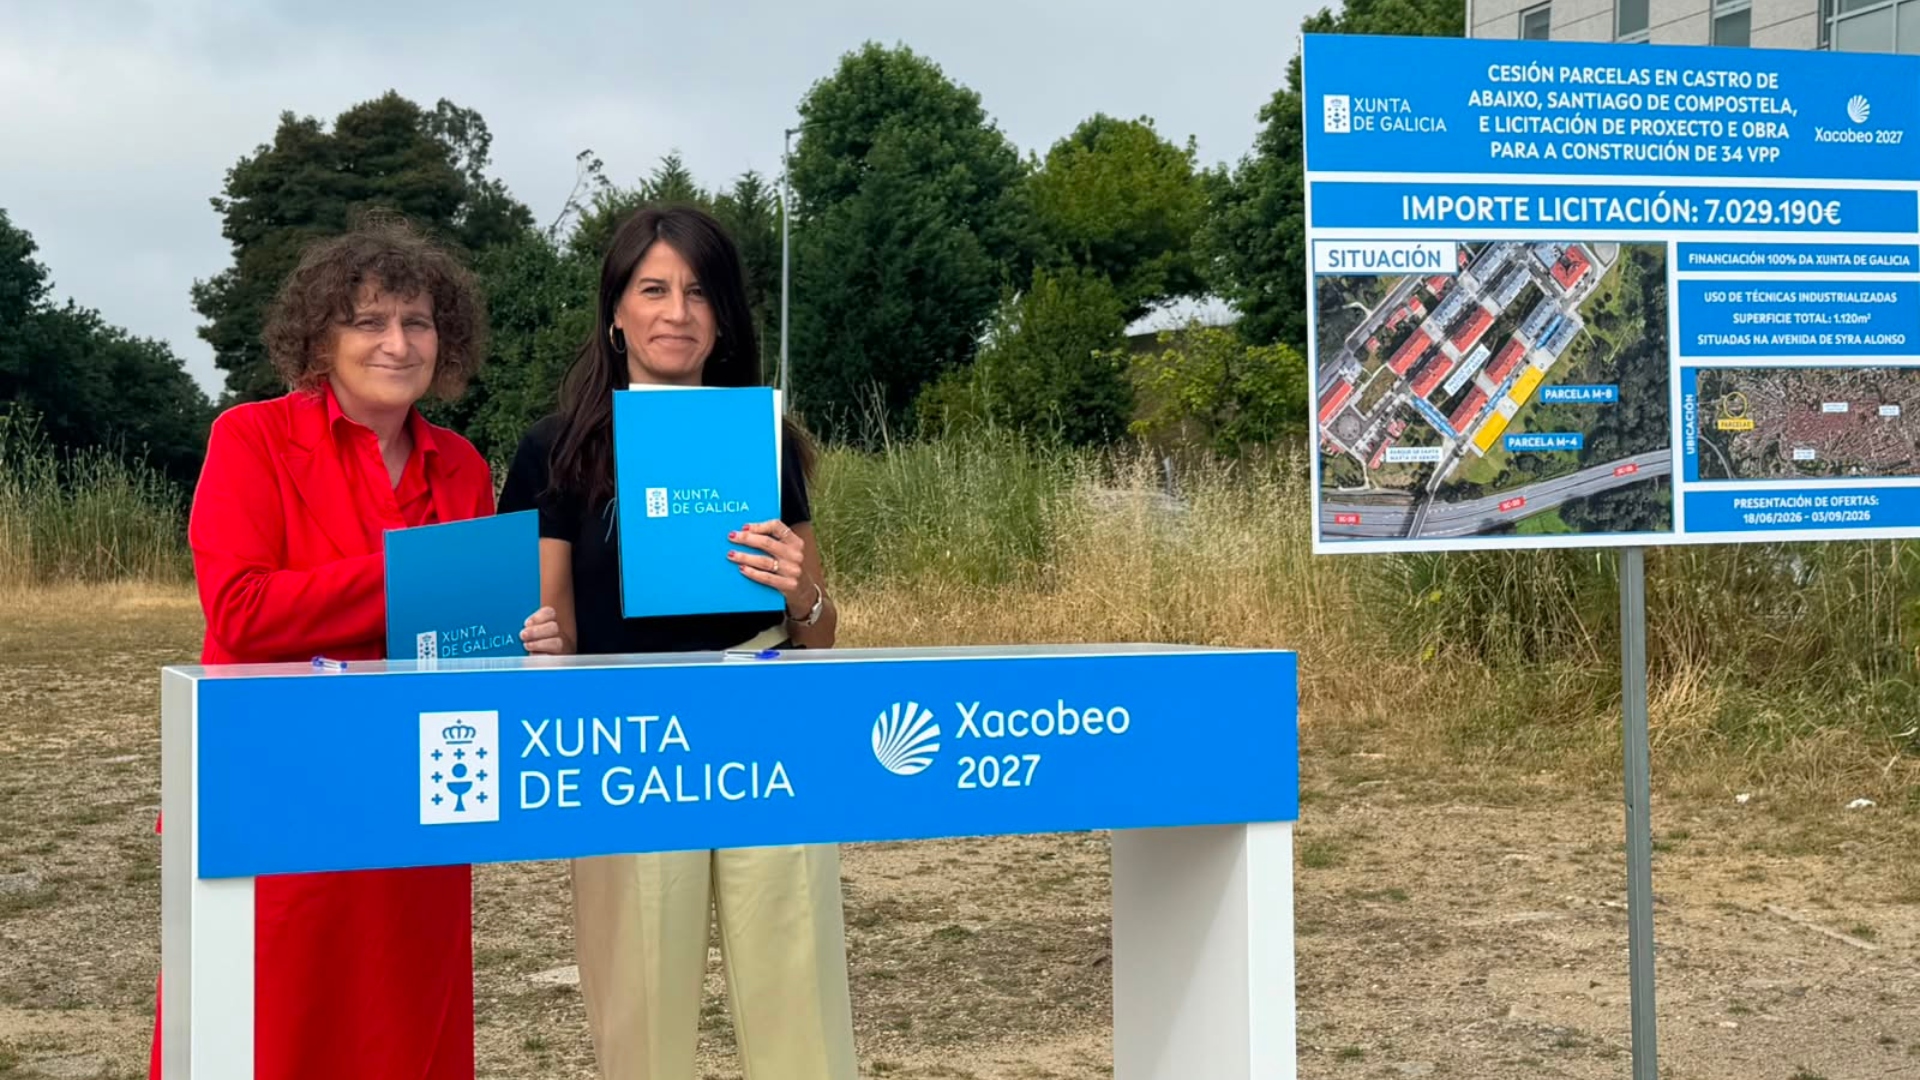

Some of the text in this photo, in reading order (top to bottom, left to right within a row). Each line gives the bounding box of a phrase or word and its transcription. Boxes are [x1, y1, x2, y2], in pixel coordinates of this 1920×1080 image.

[1488, 61, 1778, 89] CESIÓN PARCELAS EN CASTRO DE
[1355, 98, 1411, 113] XUNTA
[1469, 90, 1797, 116] ABAIXO, SANTIAGO DE COMPOSTELA,
[1354, 116, 1446, 132] DE GALICIA
[1480, 113, 1789, 138] E LICITACIÓN DE PROXECTO E OBRA
[1815, 128, 1903, 143] Xacobeo 2027
[1491, 140, 1780, 162] PARA A CONSTRUCIÓN DE 34 VPP
[1403, 191, 1840, 224] IMPORTE LICITACIÓN: 7.029.190€
[1328, 244, 1442, 268] SITUACIÓN
[1689, 252, 1910, 265] FINANCIACIÓN 100% DA XUNTA DE GALICIA
[1705, 291, 1897, 302] USO DE TÉCNICAS INDUSTRIALIZADAS
[1733, 313, 1791, 323] SUPERFICIE
[1794, 313, 1831, 323] TOTAL:
[1698, 334, 1905, 344] SITUADAS NA AVENIDA DE SYRA ALONSO
[1545, 389, 1590, 399] PARCELA
[1683, 394, 1695, 455] UBICACIÓN
[1509, 438, 1577, 447] PARCELA M-4
[674, 489, 719, 500] XUNTA
[1734, 496, 1878, 508] PRESENTACIÓN DE OFERTAS:
[673, 502, 749, 514] DE GALICIA
[1744, 512, 1802, 524] 18/06/2026
[1812, 511, 1870, 522] 03/09/2026
[444, 626, 486, 642] XUNTA
[442, 634, 513, 658] DE GALICIA
[957, 700, 1129, 738] Xacobeo
[522, 716, 690, 757] XUNTA
[958, 755, 1040, 788] 2027
[521, 762, 794, 809] DE GALICIA
